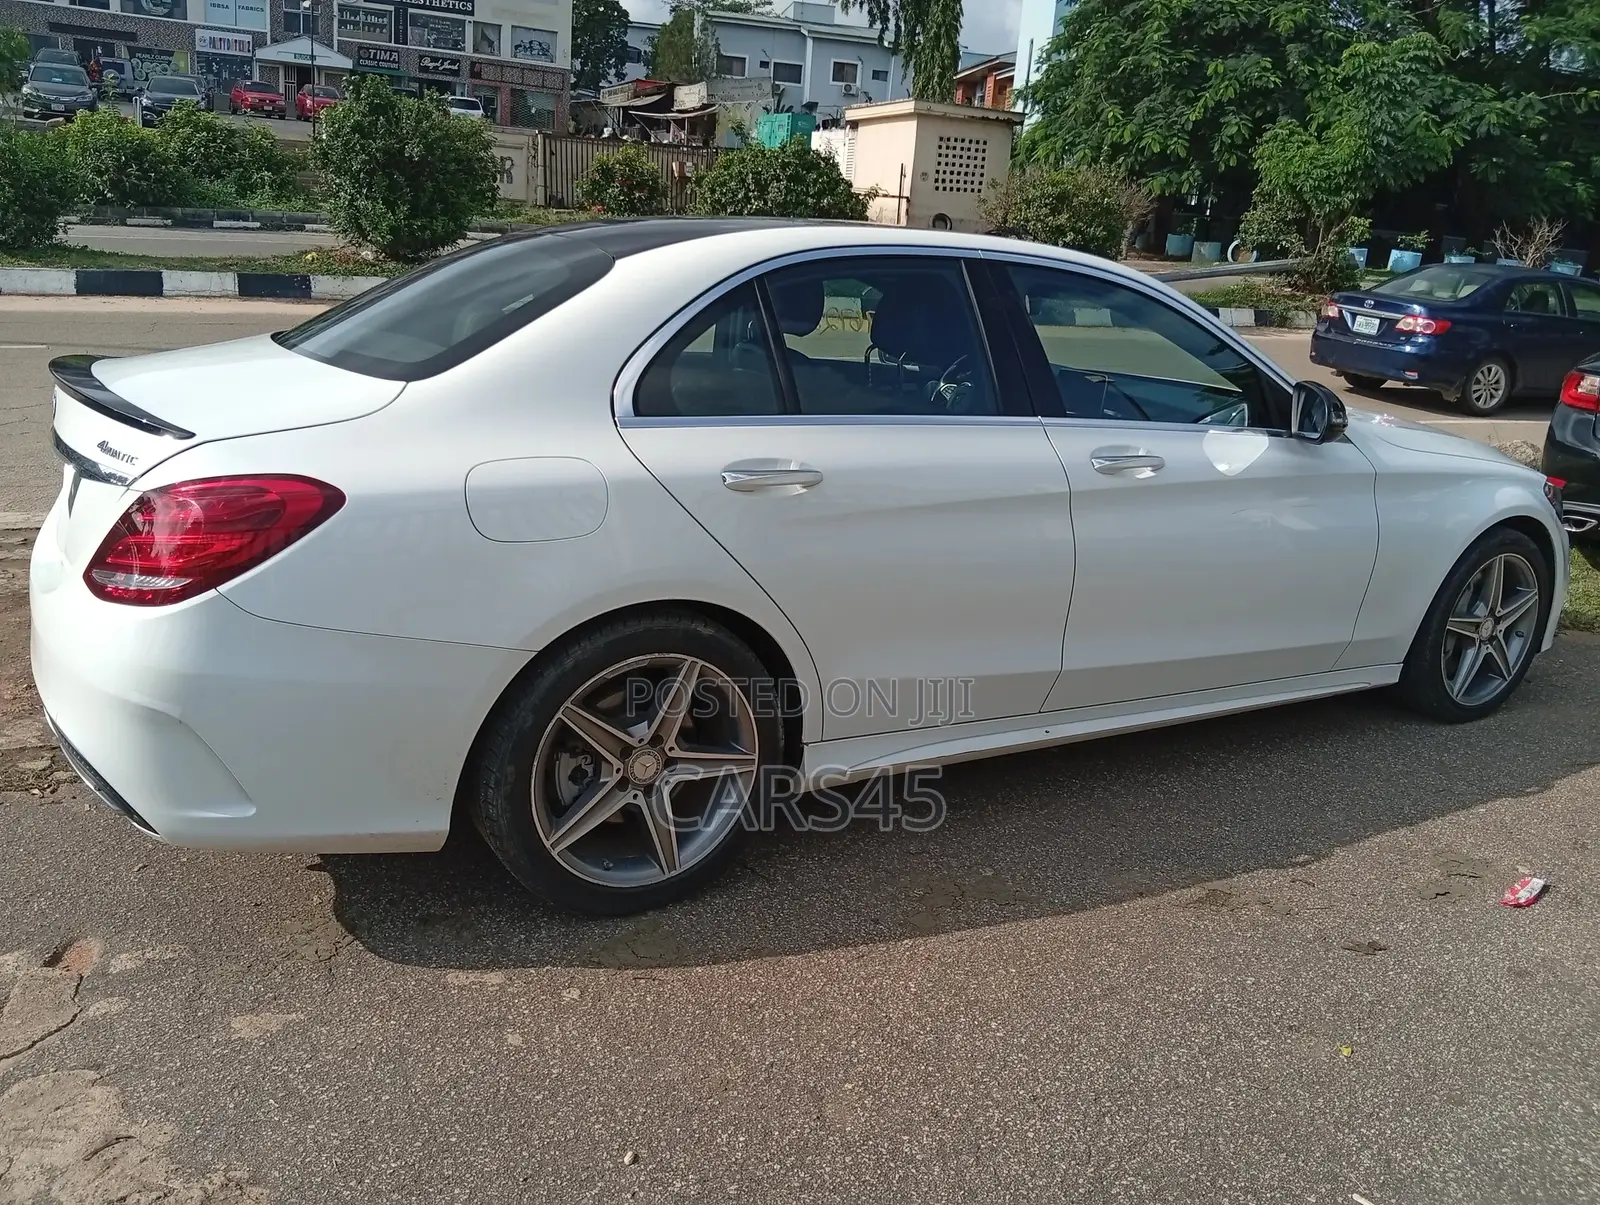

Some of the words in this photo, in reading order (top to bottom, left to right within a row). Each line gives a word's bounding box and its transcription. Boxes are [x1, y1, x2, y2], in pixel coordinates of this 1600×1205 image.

[237, 4, 265, 13] FABRICS
[369, 49, 399, 62] TIMA
[96, 439, 139, 466] 4MATIC
